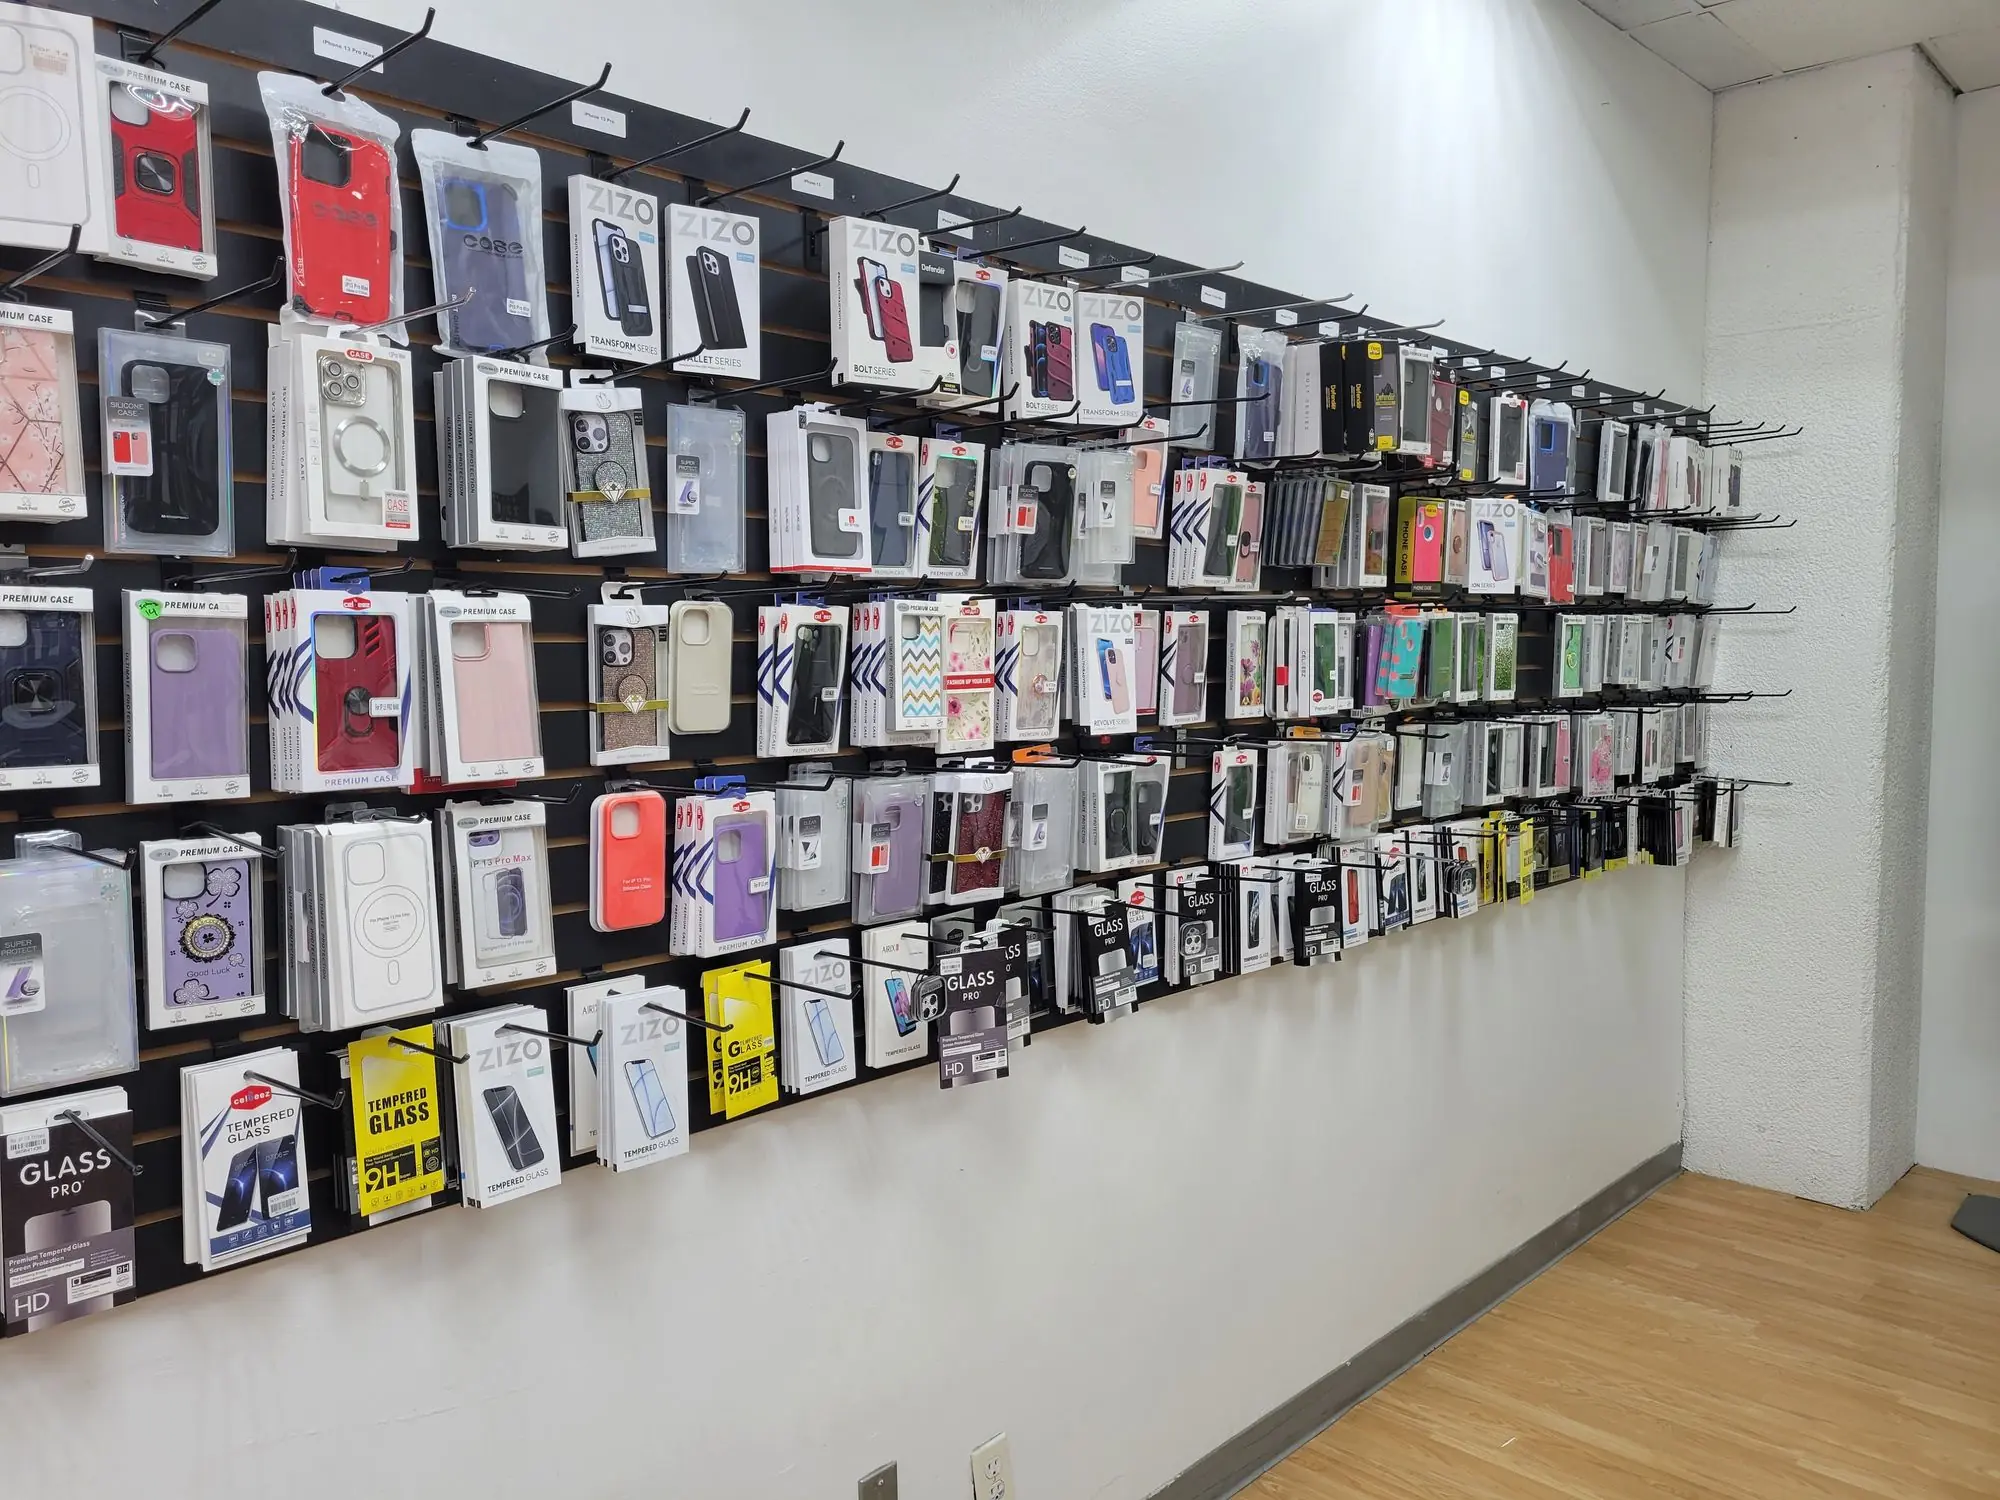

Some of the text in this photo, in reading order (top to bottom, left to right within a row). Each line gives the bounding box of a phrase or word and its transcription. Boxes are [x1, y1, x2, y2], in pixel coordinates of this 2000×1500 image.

[322, 38, 342, 50] iPhone
[351, 47, 362, 56] Pro
[362, 50, 375, 59] Max
[127, 69, 167, 87] PREMIUM
[170, 81, 191, 94] CASE
[586, 183, 654, 225] ZIZO
[677, 211, 755, 246] ZIZO
[463, 234, 524, 253] case
[852, 224, 915, 257] ZIZO
[297, 257, 305, 278] BEST
[921, 263, 946, 275] Defender
[1022, 285, 1071, 312] ZIZO
[1083, 296, 1141, 321] ZIZO
[28, 313, 53, 324] CASE
[591, 335, 658, 356] TRANSFORM SERIES
[349, 350, 371, 361] CASE
[714, 356, 741, 368] SERIES
[499, 366, 532, 379] PREMIUM
[533, 371, 550, 382] CASE
[854, 364, 896, 377] BOLT SERIES
[110, 400, 144, 410] SILICONE
[1026, 401, 1058, 412] BOLT SERIES
[1083, 409, 1138, 418] TRANSFORM SERIES
[386, 500, 408, 512] CASE
[1475, 503, 1516, 518] ZIZO
[1400, 520, 1410, 577] PHONE CASE
[3, 594, 74, 605] PREMIUM CASE
[164, 601, 206, 611] PREMIUM
[463, 608, 497, 616] PREMIUM
[499, 608, 516, 616] CASE
[1091, 613, 1133, 634] ZIZO
[324, 774, 397, 787] PREMIUM CASE
[480, 813, 531, 825] PREMIUM CASE
[180, 846, 221, 858] PREMIUM
[222, 844, 244, 854] CASE
[482, 858, 492, 867] 13
[495, 856, 511, 865] Pro
[513, 853, 531, 863] Max
[1310, 880, 1336, 894] GLASS
[1188, 893, 1214, 908] GLASS
[1094, 918, 1123, 937] GLASS
[4, 939, 33, 948] SUPER
[719, 938, 766, 952] PREMIUM CASE
[1104, 936, 1115, 946] PRO
[2, 946, 38, 956] PROTECT
[1305, 946, 1317, 956] HD
[187, 967, 231, 978] Good Luck
[801, 961, 846, 986] ZIZO
[1186, 963, 1197, 975] HD
[947, 970, 995, 991] GLASS
[962, 991, 980, 1001] PRO
[1098, 998, 1111, 1012] HD
[621, 1015, 680, 1046] ZIZO
[477, 1037, 542, 1073] ZIZO
[728, 1040, 763, 1058] GLASS
[885, 1044, 921, 1057] TEMPERED GLASS
[804, 1065, 848, 1083] TEMPERED GLASS
[945, 1062, 964, 1077] HD
[729, 1069, 751, 1096] 9H
[368, 1087, 427, 1113] TEMPERED
[226, 1108, 295, 1133] TEMPERED
[369, 1102, 430, 1135] GLASS
[227, 1126, 271, 1144] GLASS
[624, 1137, 679, 1159] TEMPERED GLASS
[20, 1149, 112, 1186] GLASS
[365, 1162, 400, 1194] 9H
[487, 1168, 549, 1193] TEMPERED GLASS
[51, 1181, 82, 1199] PRO
[8, 1241, 90, 1267] Premium Tempered Glass
[9, 1264, 32, 1275] Screen
[32, 1256, 65, 1269] Protection
[117, 1264, 130, 1275] 9H
[15, 1292, 50, 1318] HD
